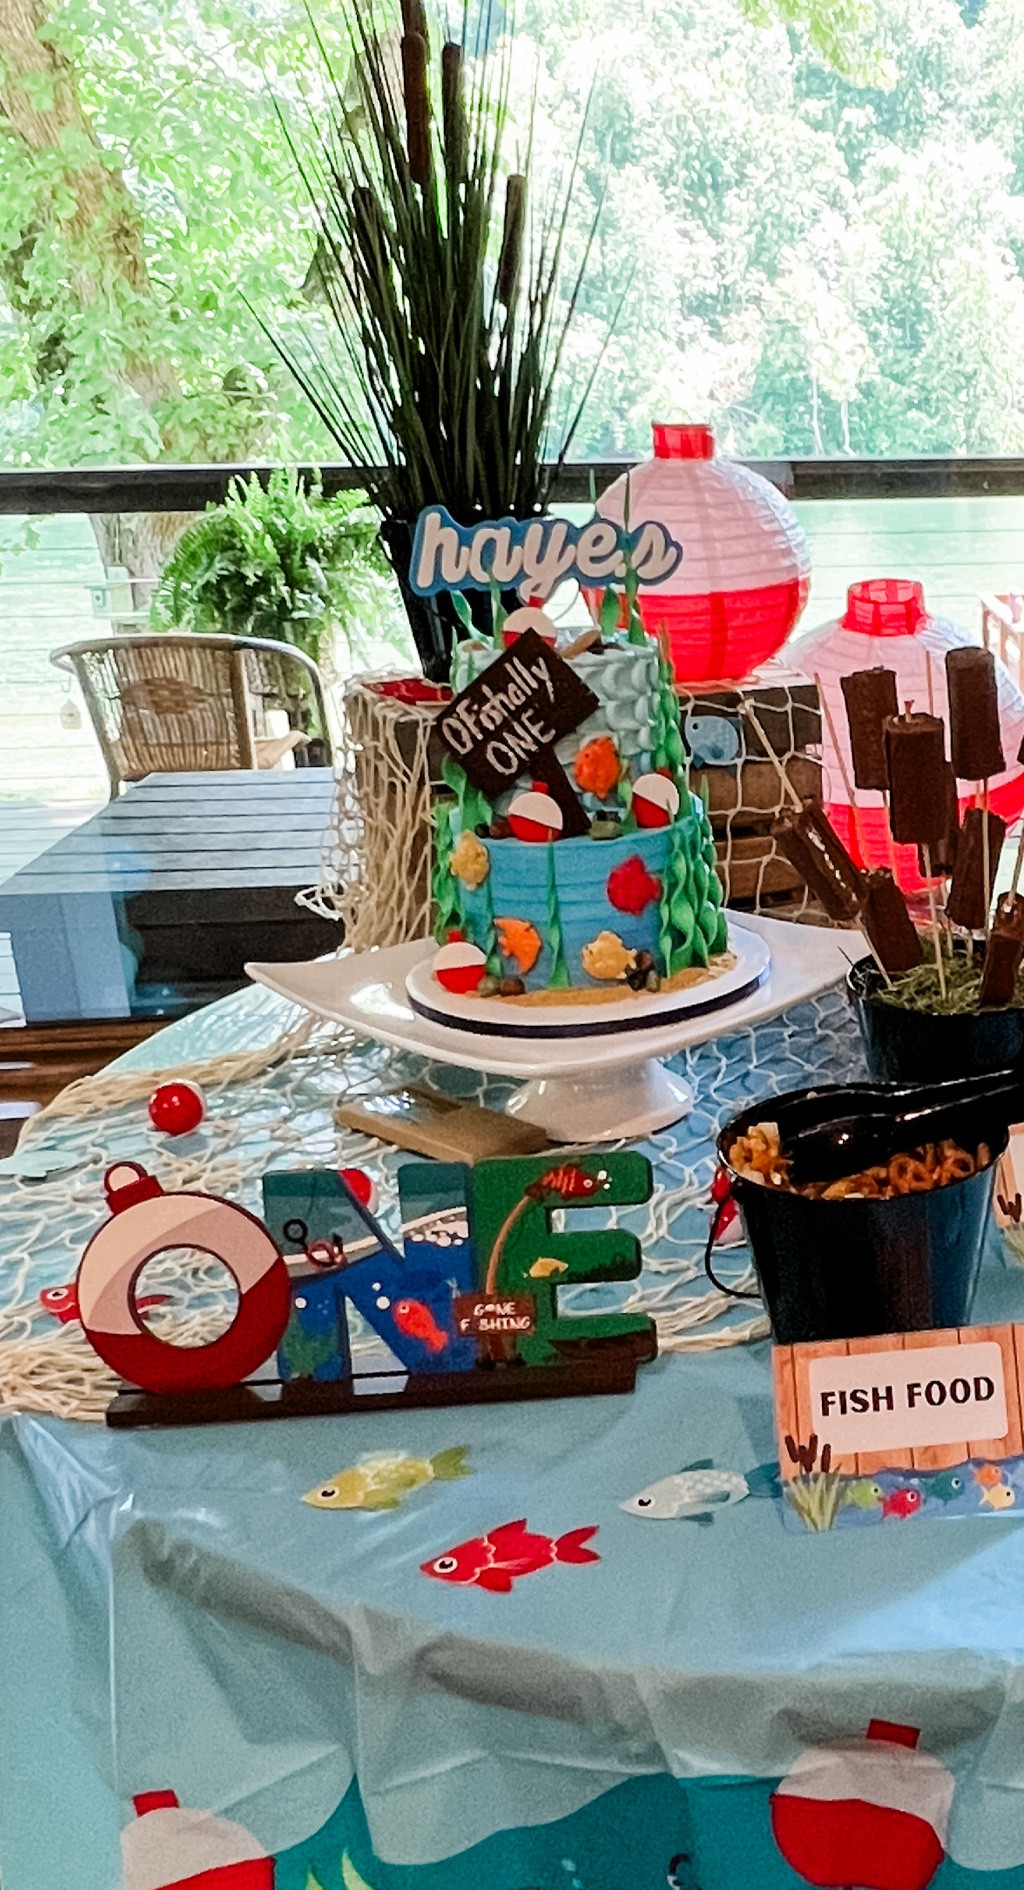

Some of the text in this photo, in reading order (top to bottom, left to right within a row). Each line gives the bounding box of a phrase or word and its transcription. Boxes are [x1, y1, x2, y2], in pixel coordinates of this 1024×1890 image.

[416, 511, 678, 602] hayes
[485, 711, 556, 776] ONE
[459, 1315, 531, 1332] FSHING
[473, 1301, 516, 1317] GONE
[819, 1375, 995, 1418] FISH FOOD
